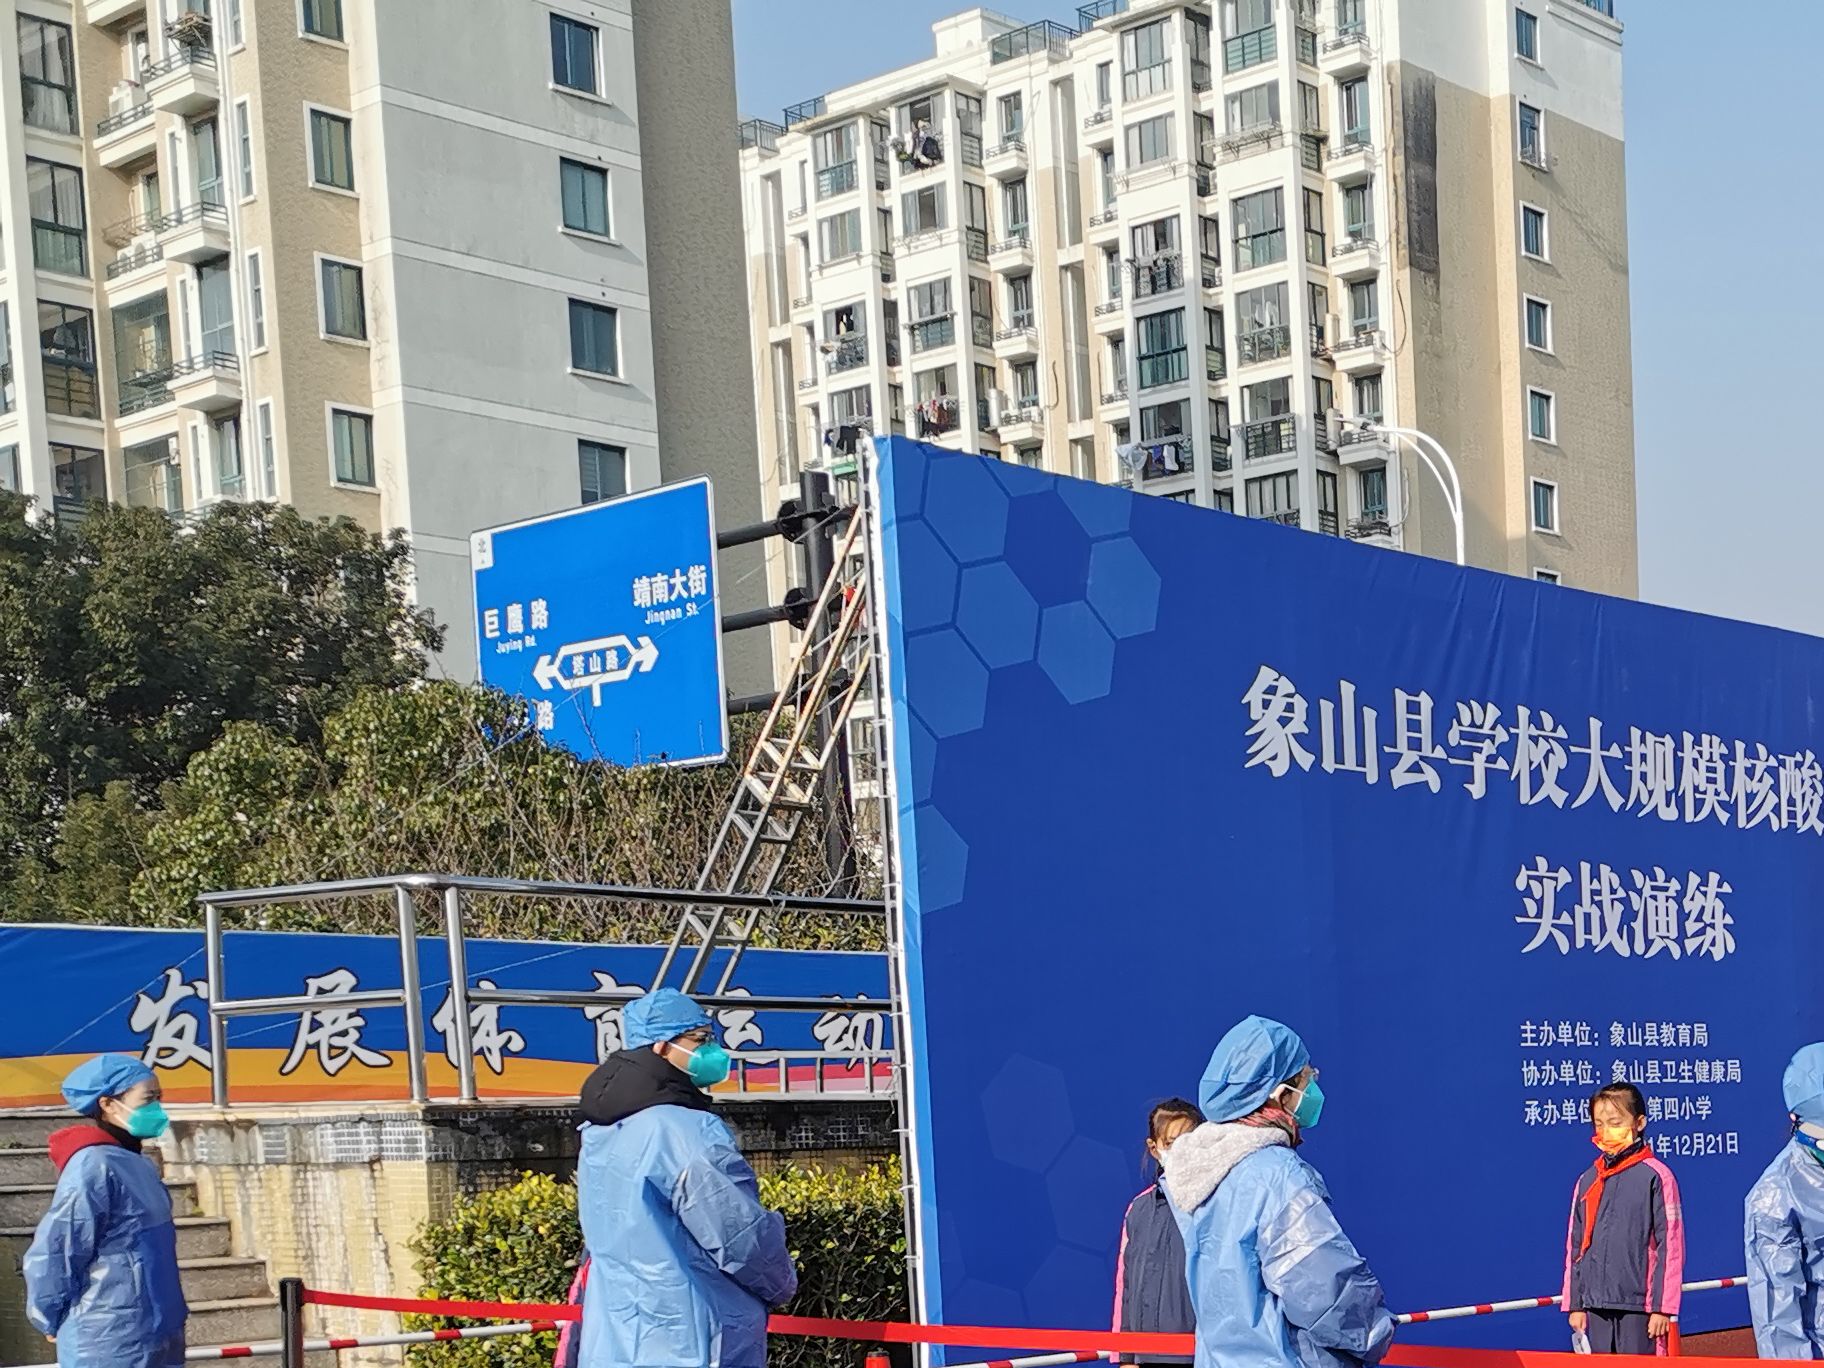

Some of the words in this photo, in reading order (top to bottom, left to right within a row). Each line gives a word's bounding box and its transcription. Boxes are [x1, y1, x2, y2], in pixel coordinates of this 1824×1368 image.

[632, 564, 707, 609] 靖南大街
[484, 598, 549, 639] 巨鹰路
[645, 609, 683, 626] Jingnan
[572, 649, 619, 676] 塔山路
[1514, 856, 1737, 961] 实战演练
